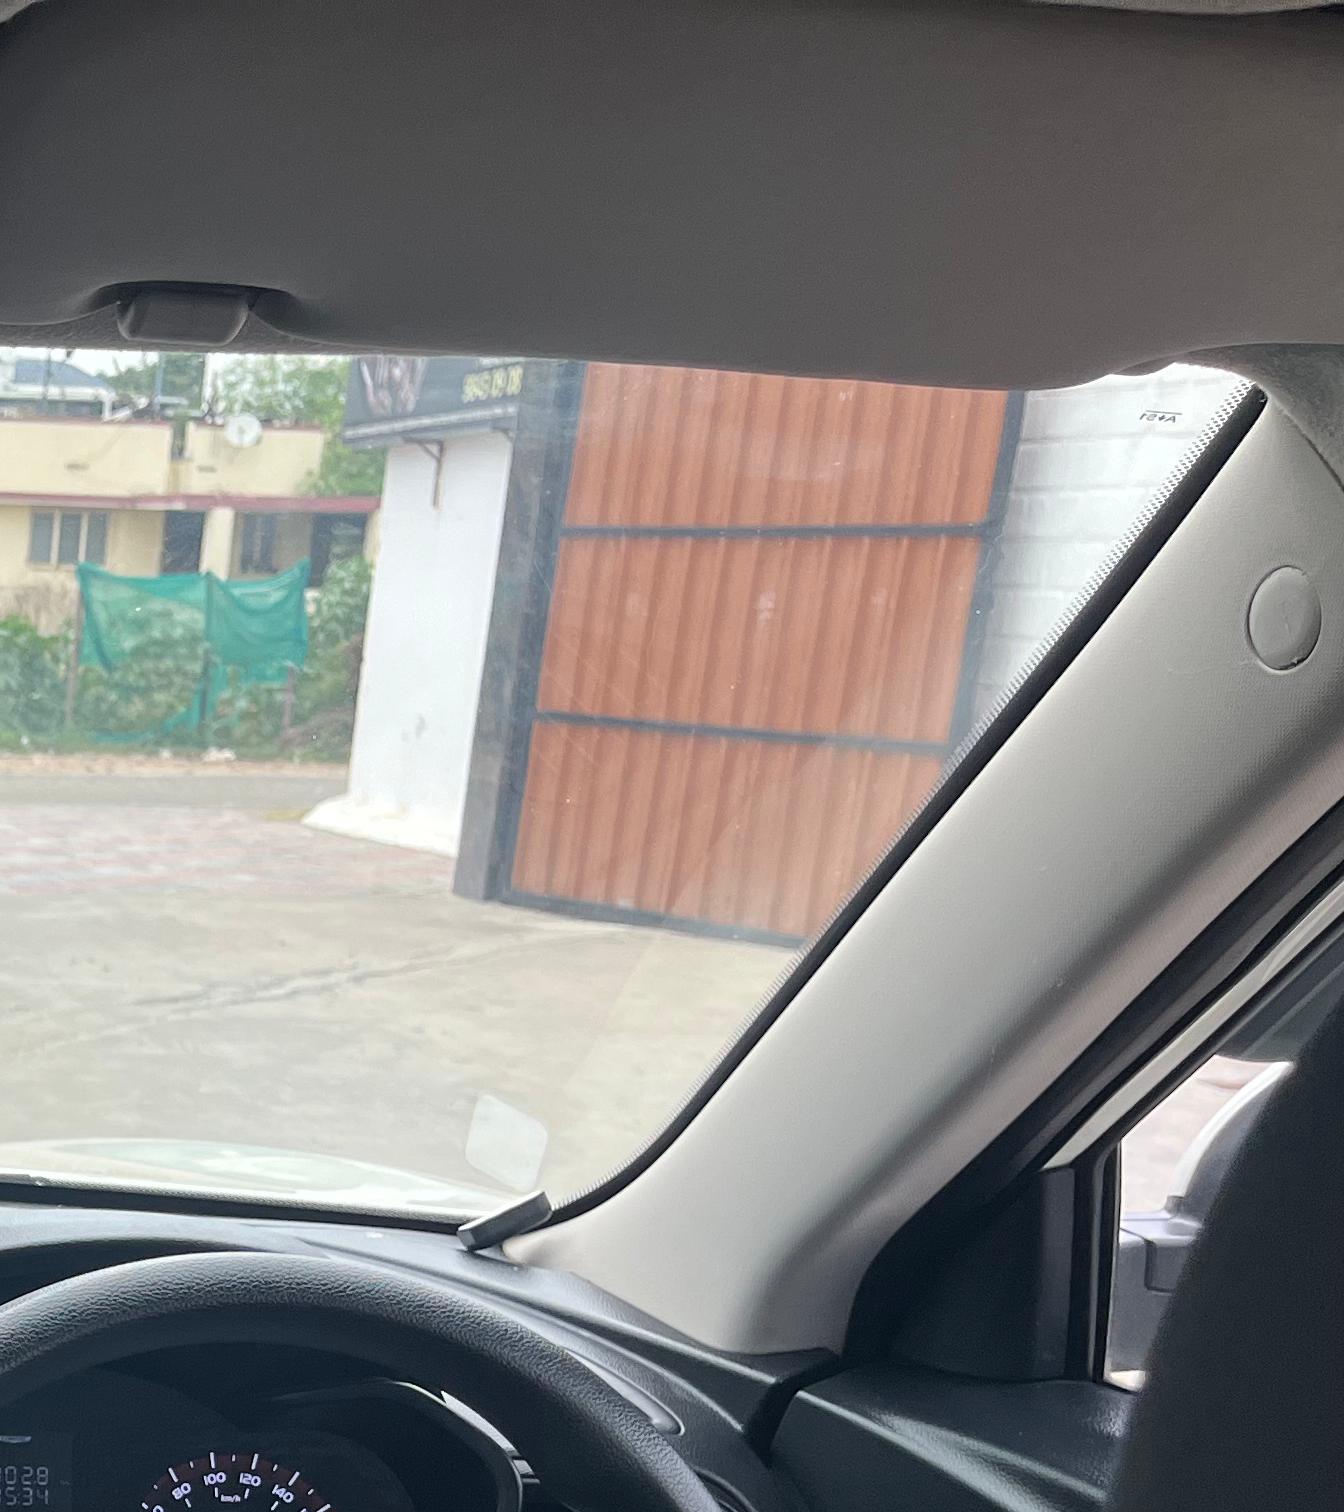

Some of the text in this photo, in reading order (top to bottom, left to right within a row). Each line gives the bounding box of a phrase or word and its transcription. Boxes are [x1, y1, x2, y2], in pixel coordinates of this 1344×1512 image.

[203, 1471, 227, 1486] 100
[239, 1472, 262, 1487] 120
[171, 1482, 192, 1501] 80
[220, 1494, 242, 1503] km/h
[271, 1483, 294, 1503] 140
